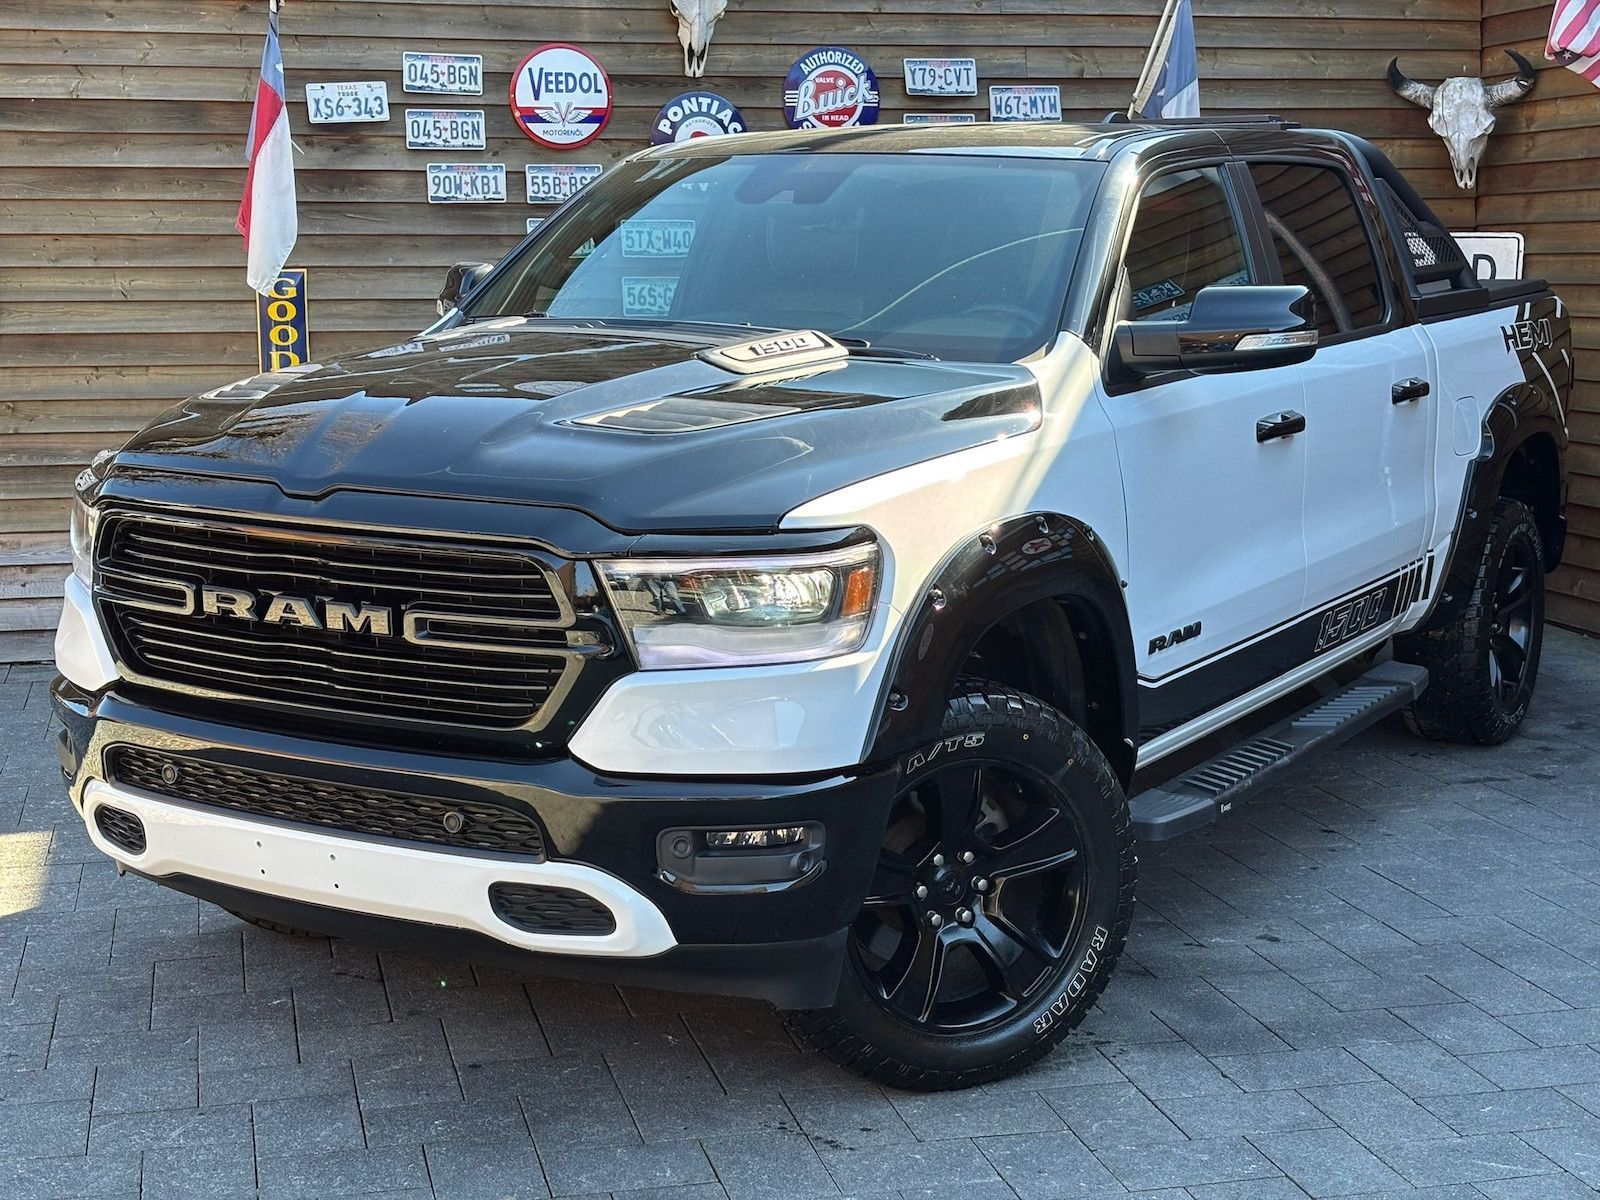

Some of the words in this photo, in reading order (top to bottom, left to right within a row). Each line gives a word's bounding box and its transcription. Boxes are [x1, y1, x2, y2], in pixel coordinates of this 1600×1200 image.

[408, 62, 440, 84] 045
[447, 65, 478, 86] BGN
[800, 51, 864, 75] AUTHORIZED
[527, 67, 603, 101] VEEDOL
[909, 68, 936, 86] Y79
[944, 68, 971, 86] CVT
[313, 97, 345, 118] XS6
[352, 95, 384, 117] 343
[794, 72, 876, 122] Buick
[658, 97, 743, 135] PONTIAC
[685, 119, 717, 128] AUTHORIZED
[411, 120, 443, 139] 045
[450, 120, 480, 140] BGN
[470, 175, 501, 195] KB1
[531, 176, 561, 195] 55B
[266, 278, 300, 372] GOOD
[750, 338, 811, 357] 1500
[202, 585, 394, 637] RAM
[1314, 587, 1388, 652] 1500
[1148, 621, 1202, 655] RAM
[1033, 925, 1108, 1036] RADAR
